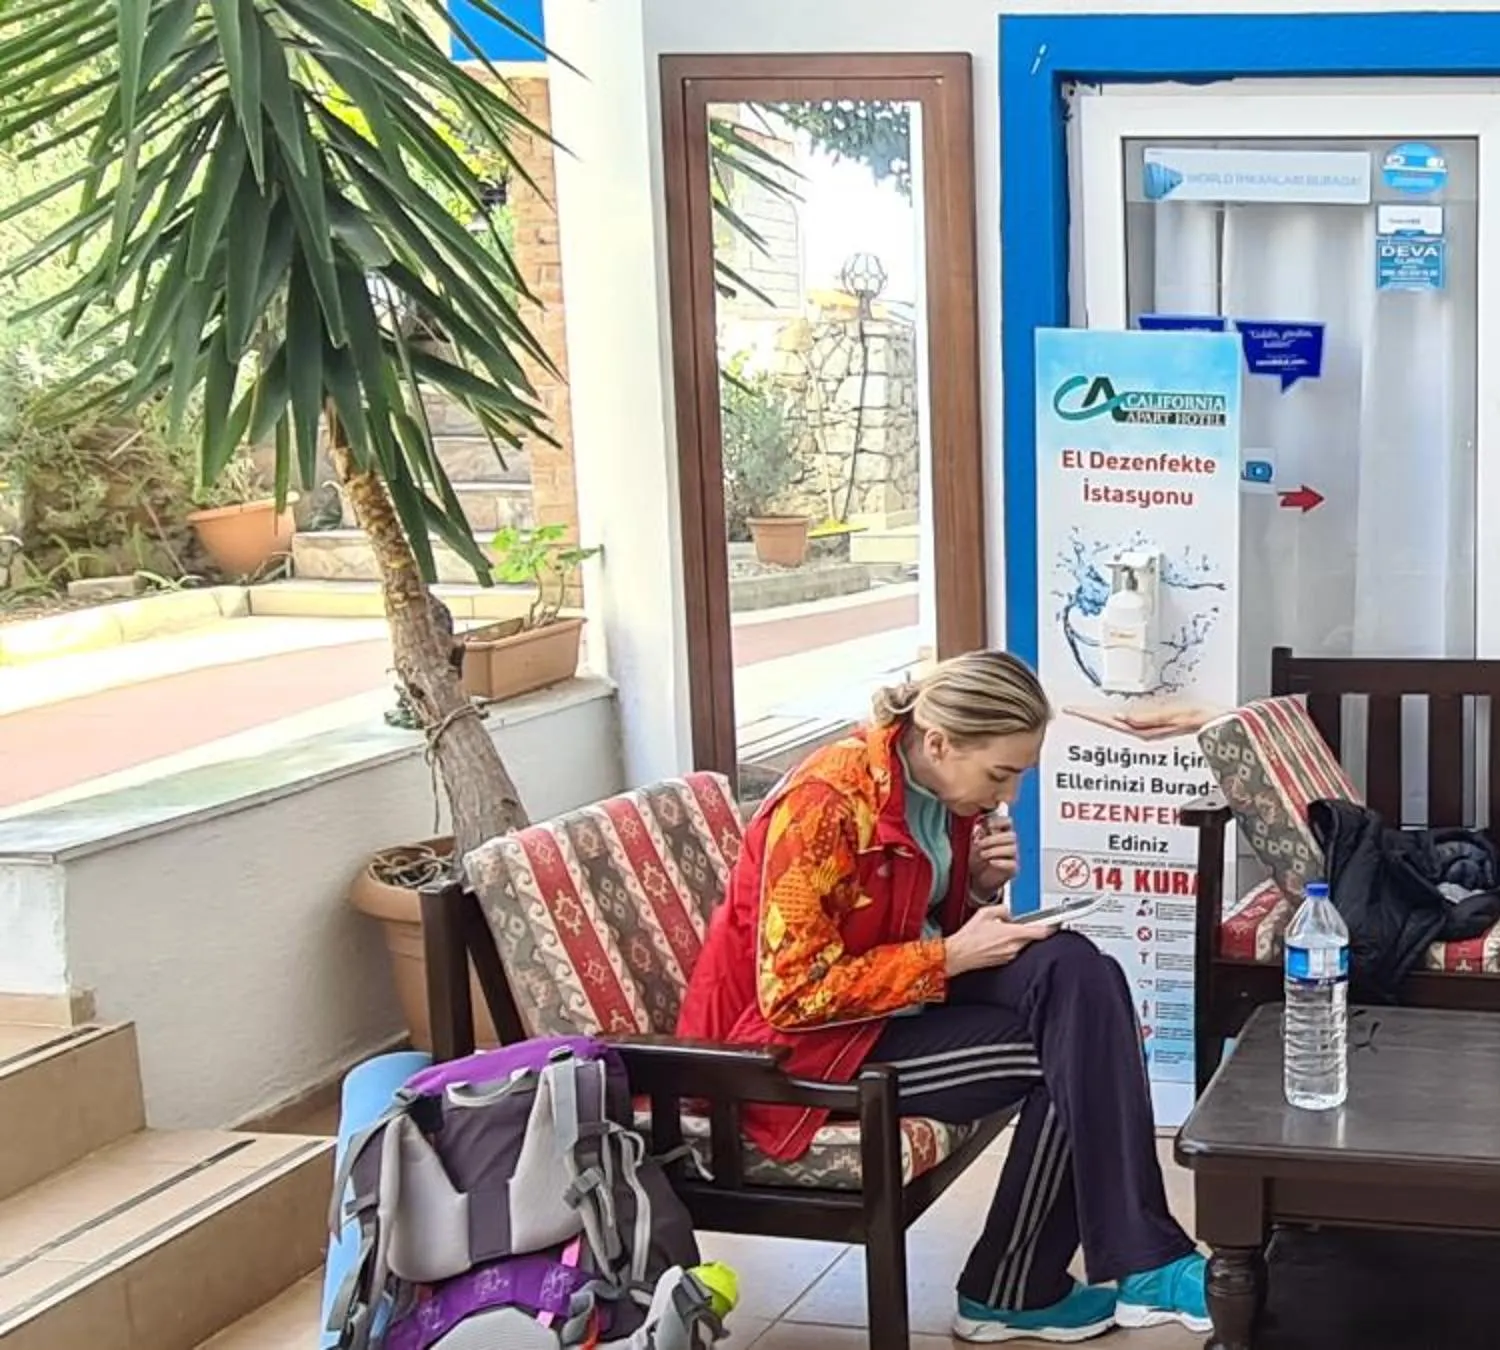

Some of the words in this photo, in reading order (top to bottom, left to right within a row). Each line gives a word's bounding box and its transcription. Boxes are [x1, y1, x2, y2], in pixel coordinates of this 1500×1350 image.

[1381, 245, 1438, 257] DEVA
[1126, 393, 1225, 411] CALIFORNIA
[1126, 411, 1170, 425] APART
[1175, 412, 1223, 427] HOTEL
[1062, 450, 1084, 469] El
[1090, 450, 1217, 474] Dezenfekte
[1083, 477, 1194, 509] İstasyonu
[1068, 745, 1168, 769] Sağlığınız
[1056, 772, 1145, 793] Ellerinizi
[1108, 834, 1169, 853] Ediniz
[1092, 867, 1123, 891] 14
